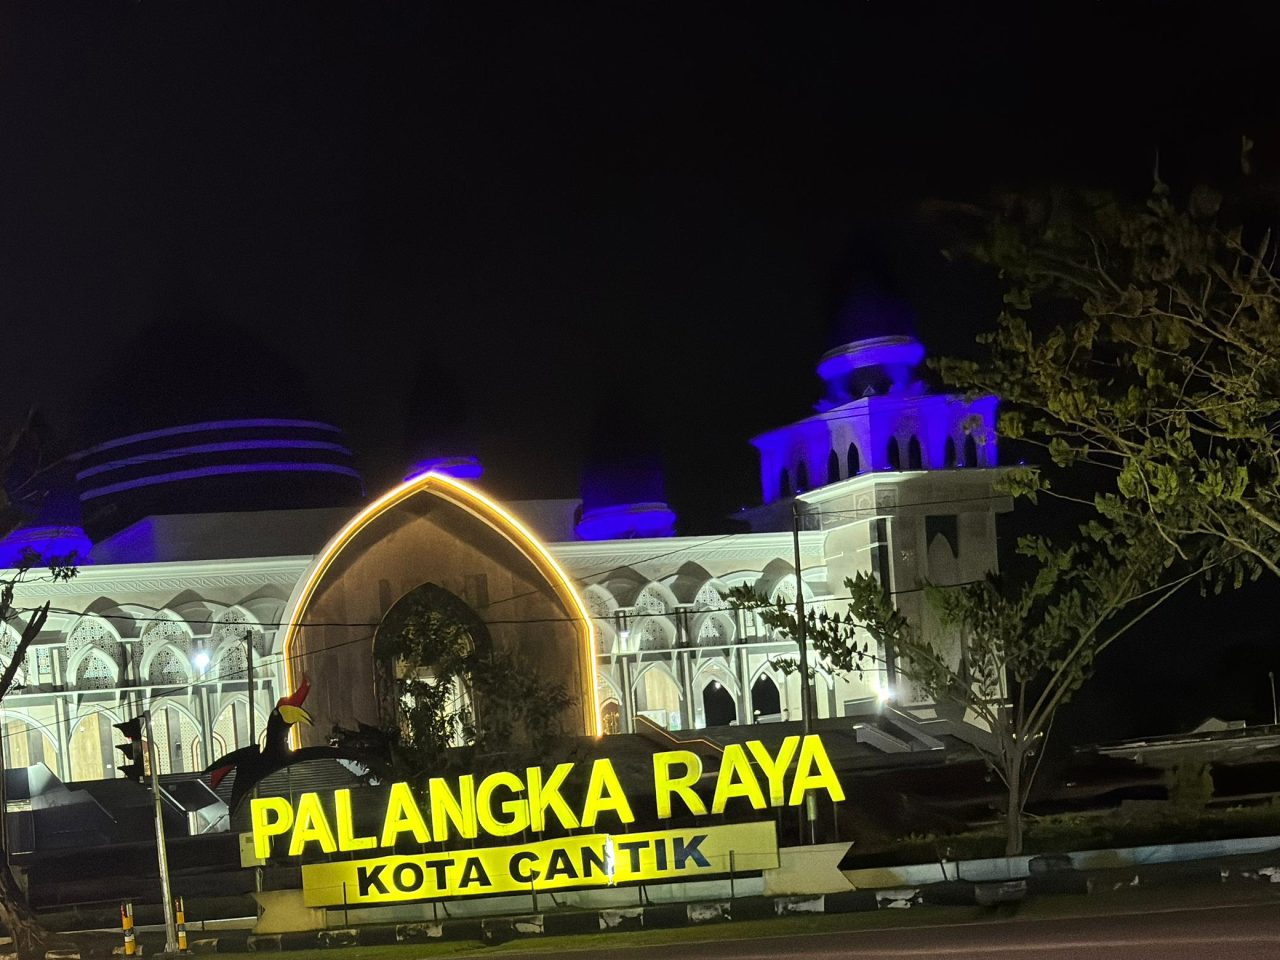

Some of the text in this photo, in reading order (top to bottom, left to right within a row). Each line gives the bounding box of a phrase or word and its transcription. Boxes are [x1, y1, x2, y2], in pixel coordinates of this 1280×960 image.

[250, 733, 847, 860] PALANGKA RAYA
[356, 834, 712, 897] KOTA CANTIK
